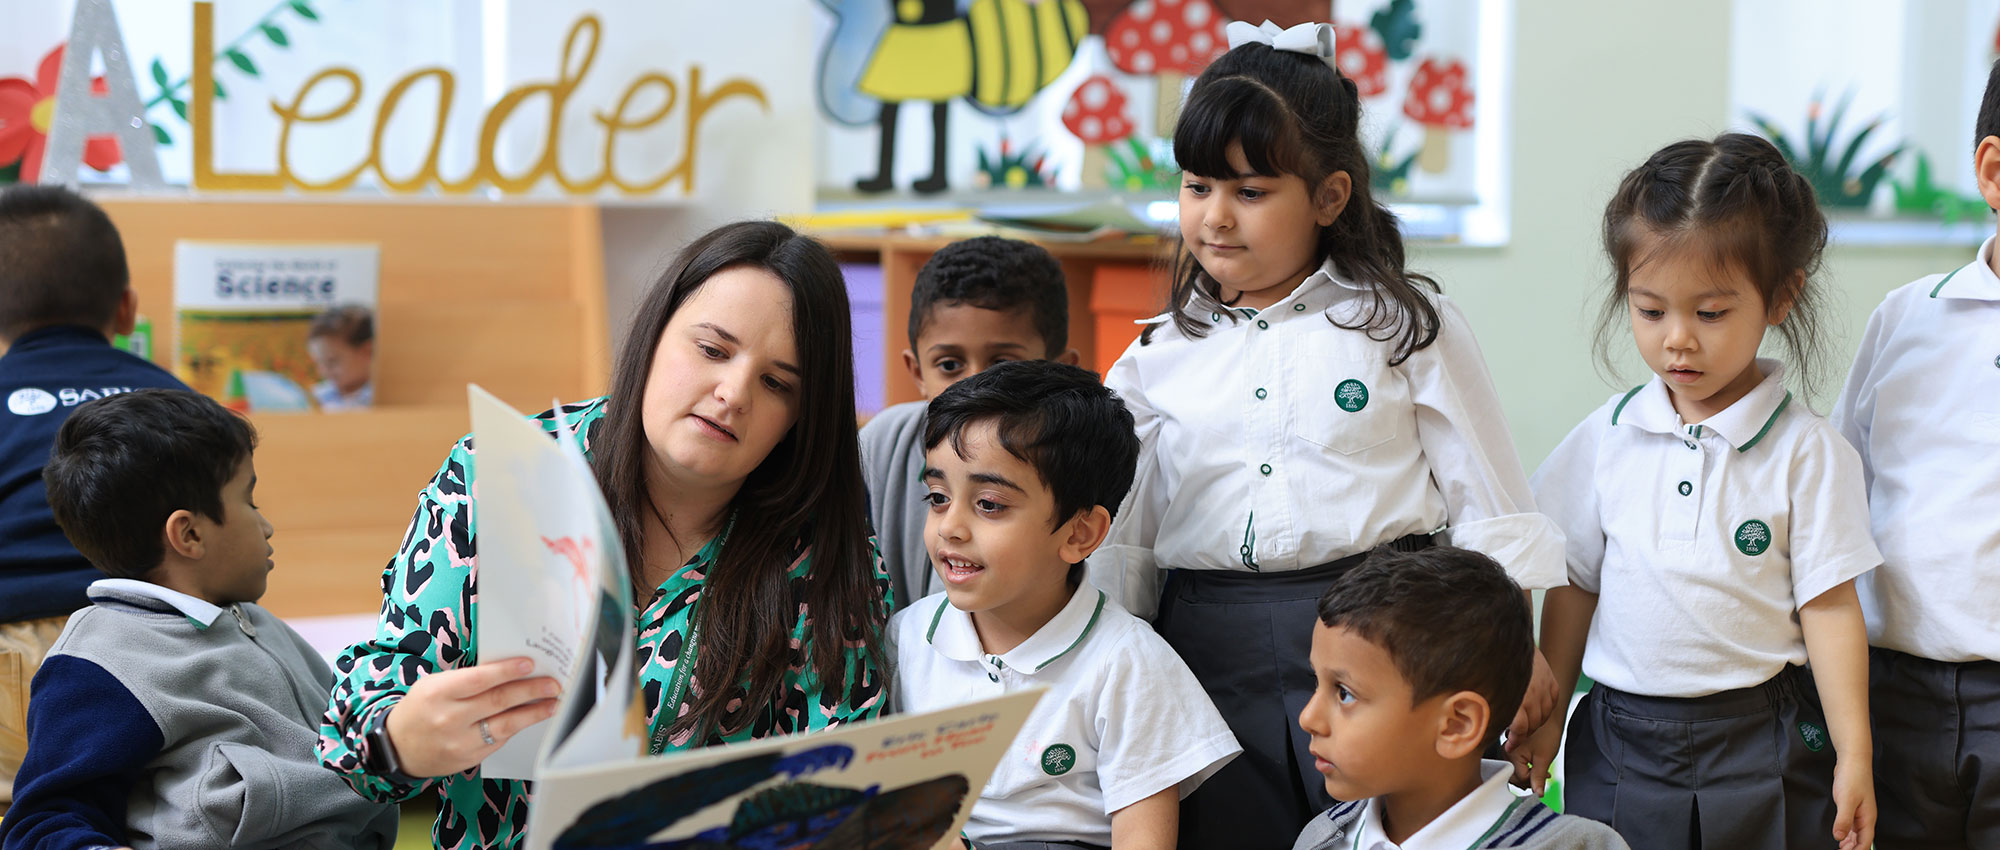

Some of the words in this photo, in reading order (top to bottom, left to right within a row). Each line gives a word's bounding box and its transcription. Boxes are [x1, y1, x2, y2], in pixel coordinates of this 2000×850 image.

[38, 0, 166, 187] A
[193, 0, 770, 194] Leader
[216, 269, 336, 298] Science
[667, 674, 684, 710] Education
[679, 663, 688, 677] for
